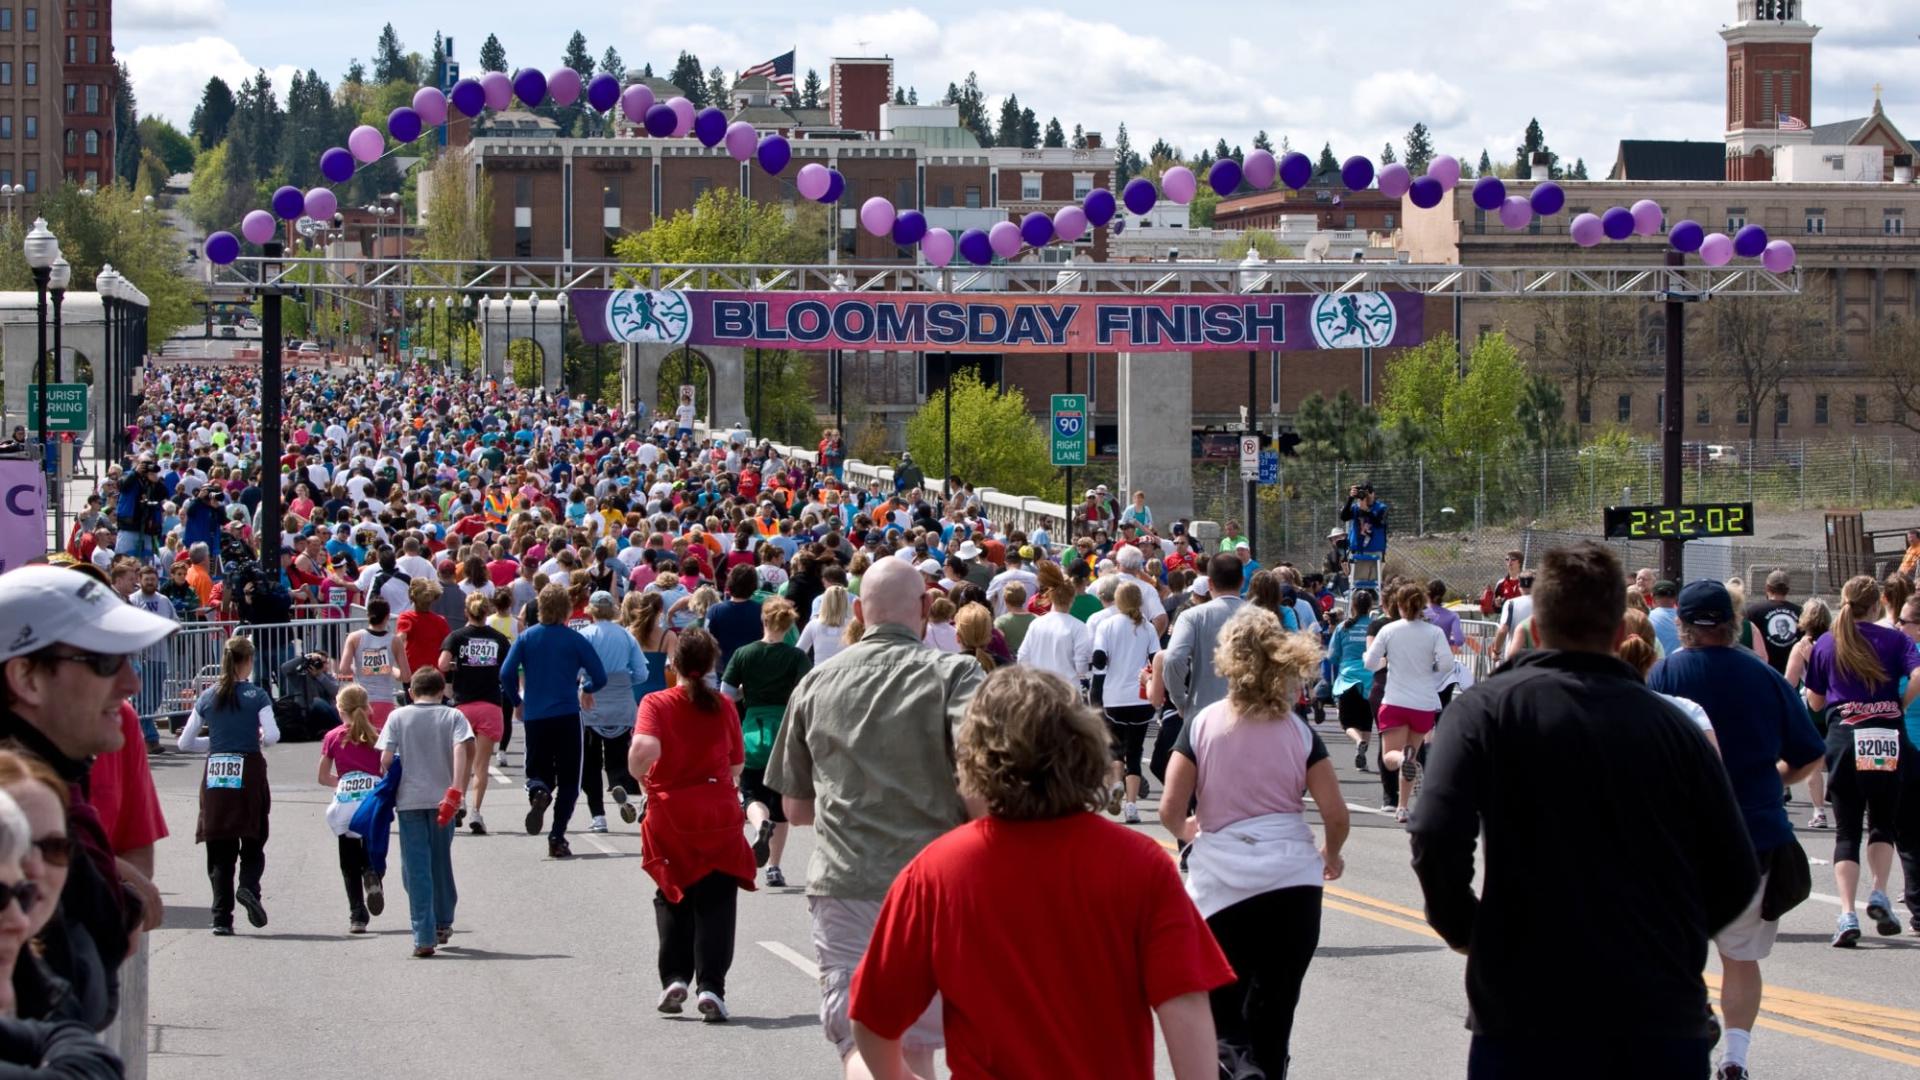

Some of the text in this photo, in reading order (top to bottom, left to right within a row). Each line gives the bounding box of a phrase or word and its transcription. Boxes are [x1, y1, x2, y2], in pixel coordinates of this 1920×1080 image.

[712, 300, 1080, 345] BLOOMSDAY
[1096, 303, 1285, 345] FINISH
[33, 390, 82, 400] TURIST
[33, 402, 83, 412] PRKING
[1062, 398, 1077, 408] TO
[1059, 418, 1079, 432] 90
[1056, 440, 1082, 450] RIGHT
[1056, 451, 1081, 461] LANE
[1857, 739, 1897, 757] 32046
[208, 761, 242, 777] 43183
